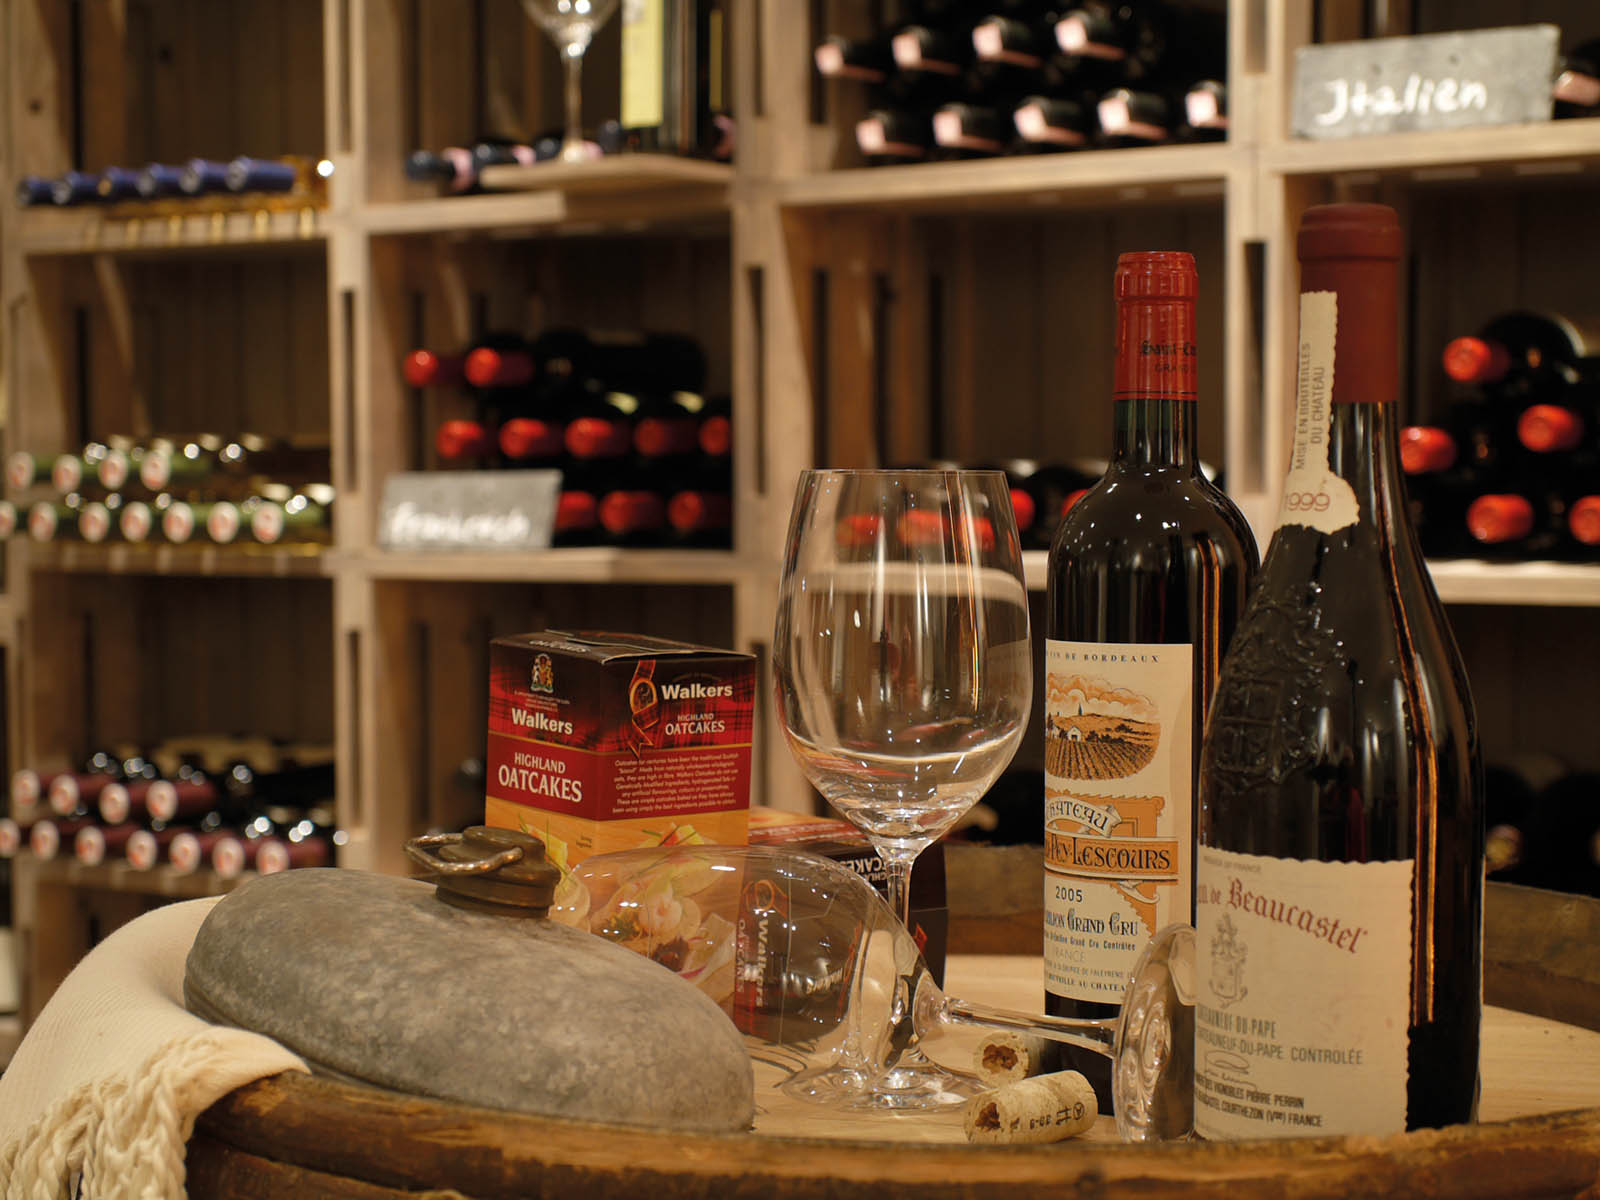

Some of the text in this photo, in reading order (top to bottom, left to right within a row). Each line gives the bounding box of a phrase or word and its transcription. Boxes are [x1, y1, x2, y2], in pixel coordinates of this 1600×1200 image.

[1295, 343, 1311, 471] MISE EN BOUTEILLES
[1310, 366, 1325, 444] DU CHATEAU
[1084, 654, 1159, 662] BORDEAUX
[660, 683, 733, 700] Walkers
[511, 707, 573, 735] Walkers
[677, 713, 715, 721] HIGHLAND
[665, 720, 725, 735] OATCAKES
[514, 752, 566, 774] HIGHLAND
[498, 764, 582, 802] OATCAKES
[1047, 800, 1108, 830] HATEAU
[1055, 886, 1083, 903] 2005
[1067, 908, 1105, 934] GRAND
[1109, 912, 1139, 936] CRU
[1227, 877, 1362, 953] Beaucastel
[1055, 947, 1086, 962] RANCE
[1090, 983, 1126, 992] CHATEA
[1288, 1112, 1322, 1127] FRANCE
